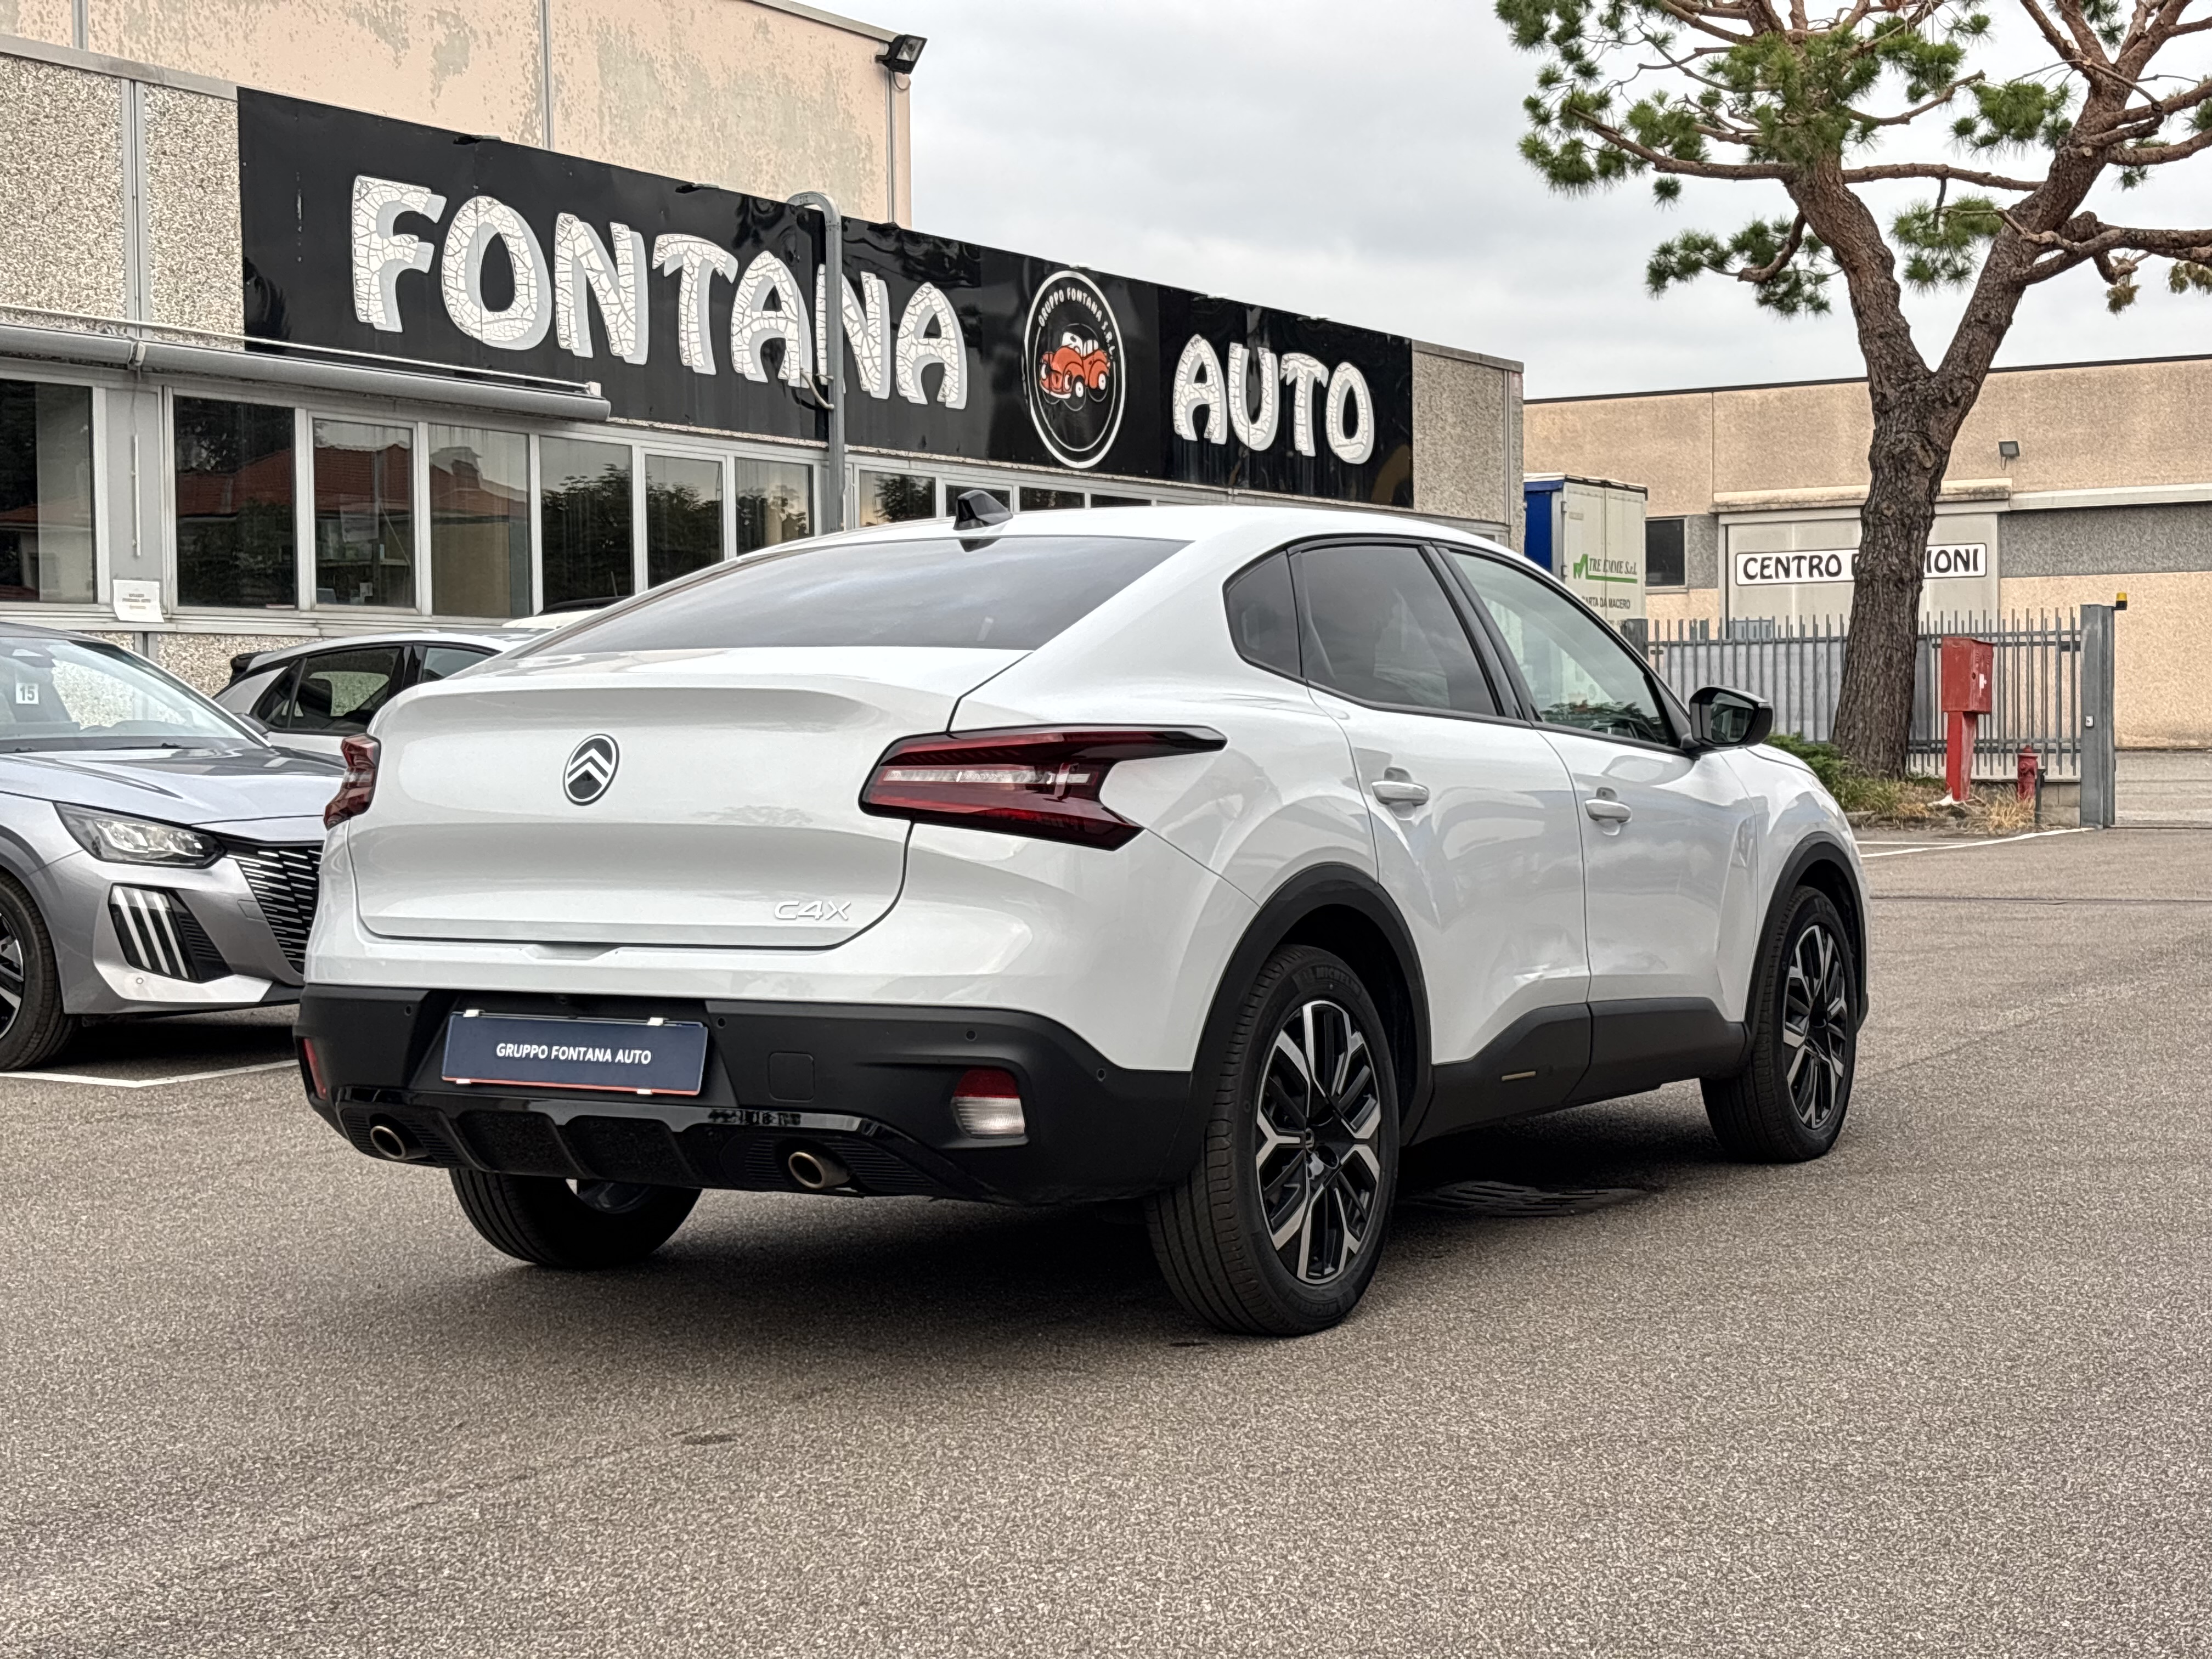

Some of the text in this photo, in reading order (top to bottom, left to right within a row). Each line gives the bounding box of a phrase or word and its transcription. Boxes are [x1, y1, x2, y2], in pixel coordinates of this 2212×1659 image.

[1038, 289, 1064, 327] GRUPPO
[1066, 287, 1102, 322] FONTANA
[353, 174, 1374, 464] FONTANA AUTO
[1589, 558, 1601, 572] TRE
[1743, 554, 1842, 580] CENTRO
[20, 685, 35, 701] 15
[496, 1043, 652, 1064] GRUPPO FONTANA AUTO
